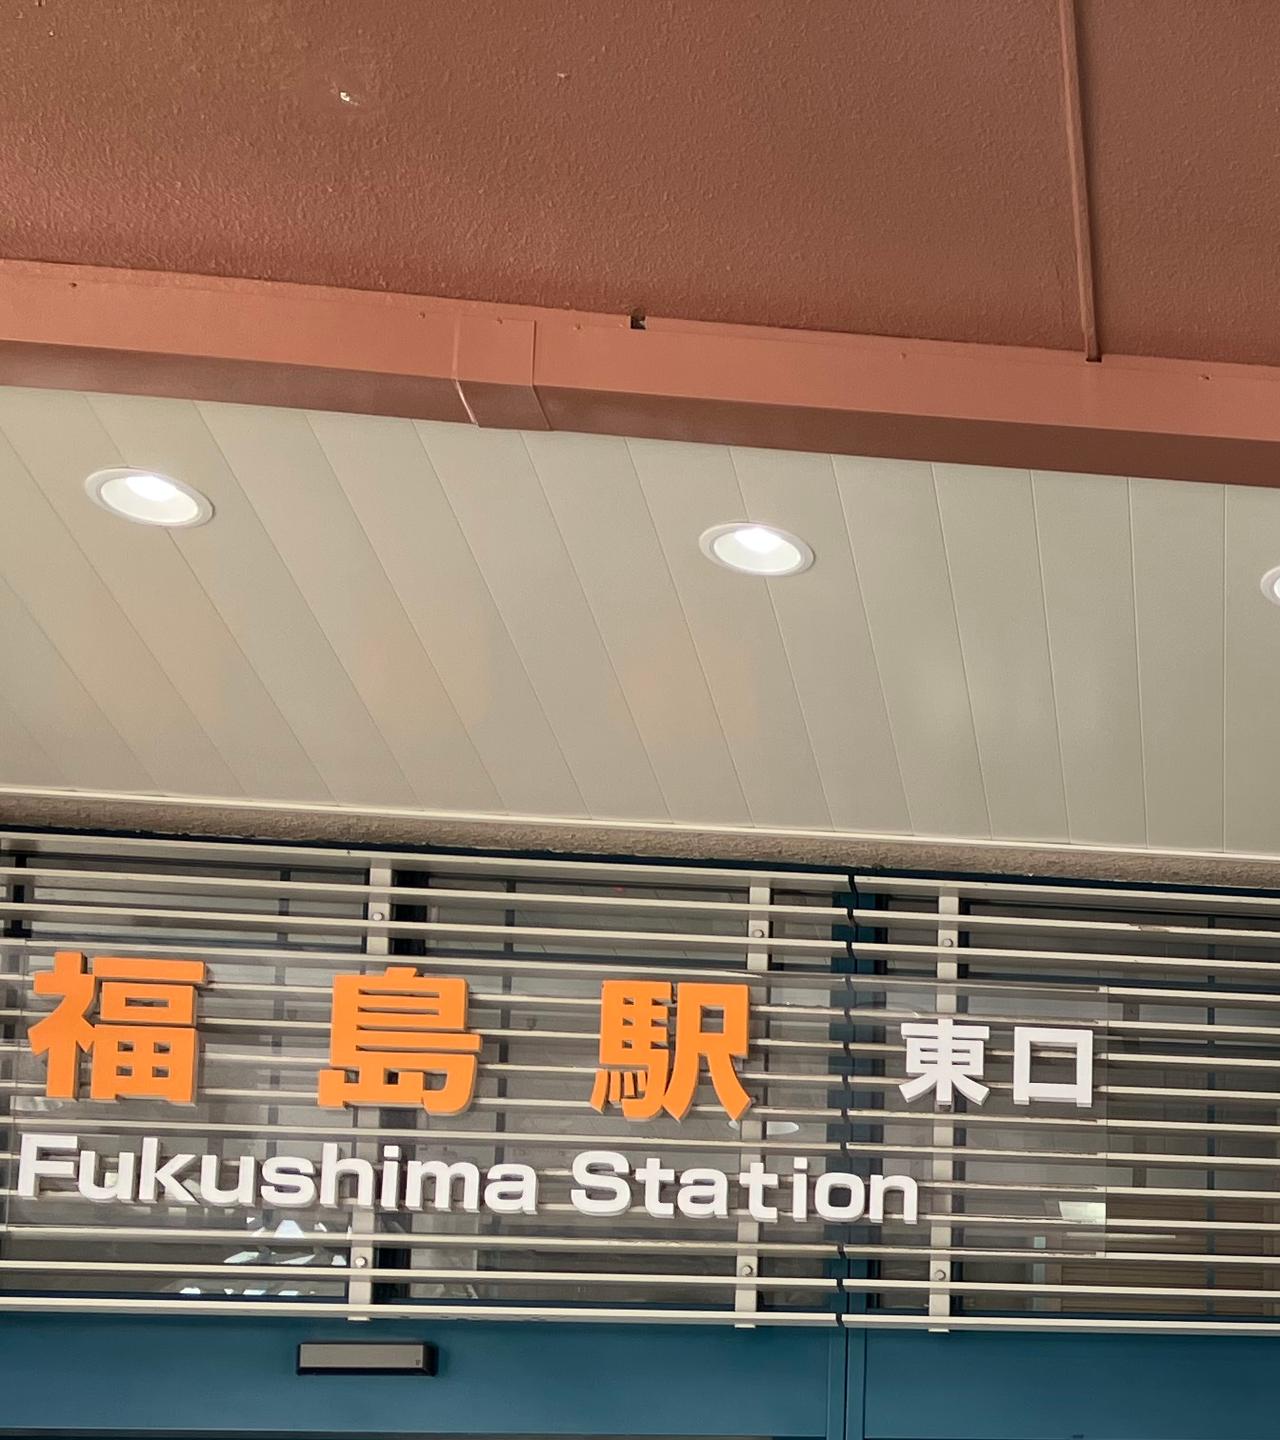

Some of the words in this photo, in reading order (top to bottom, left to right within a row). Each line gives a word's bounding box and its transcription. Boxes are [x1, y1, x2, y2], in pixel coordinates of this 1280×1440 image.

[28, 950, 753, 1121] 福島駅
[898, 1018, 1094, 1108] 東口
[17, 1133, 538, 1215] Fukushima
[569, 1151, 918, 1225] Station
